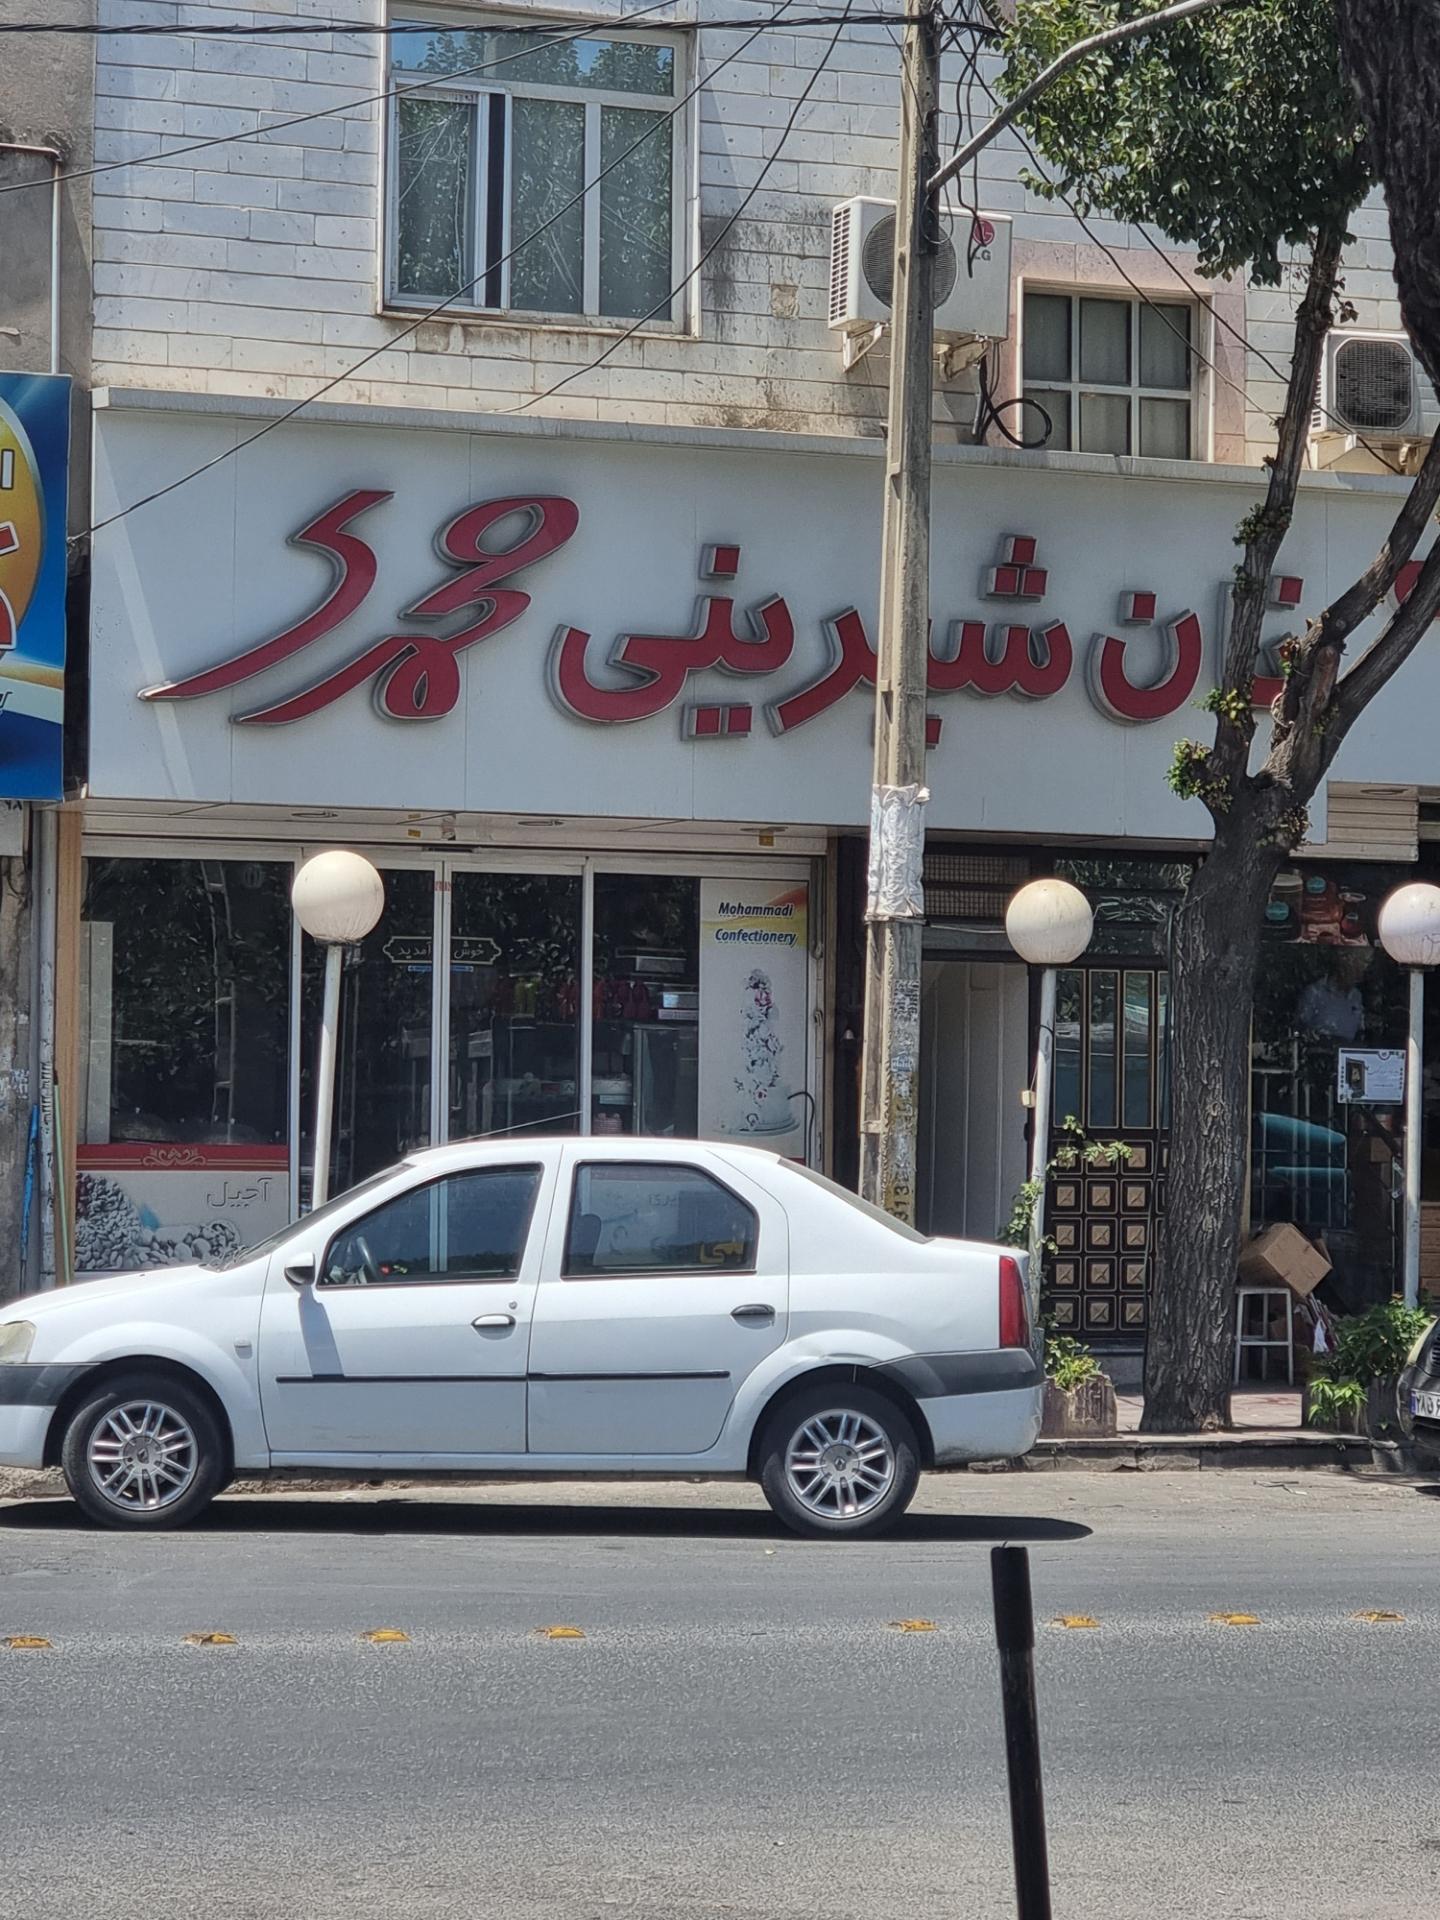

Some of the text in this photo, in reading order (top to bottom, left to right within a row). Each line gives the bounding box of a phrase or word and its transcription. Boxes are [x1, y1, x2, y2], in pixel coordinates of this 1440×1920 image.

[552, 535, 1074, 748] شرینی
[718, 902, 794, 916] Mohammadi
[715, 928, 797, 945] Confectionery
[398, 940, 485, 959] خوش آمدید
[206, 1177, 272, 1208] آجیل
